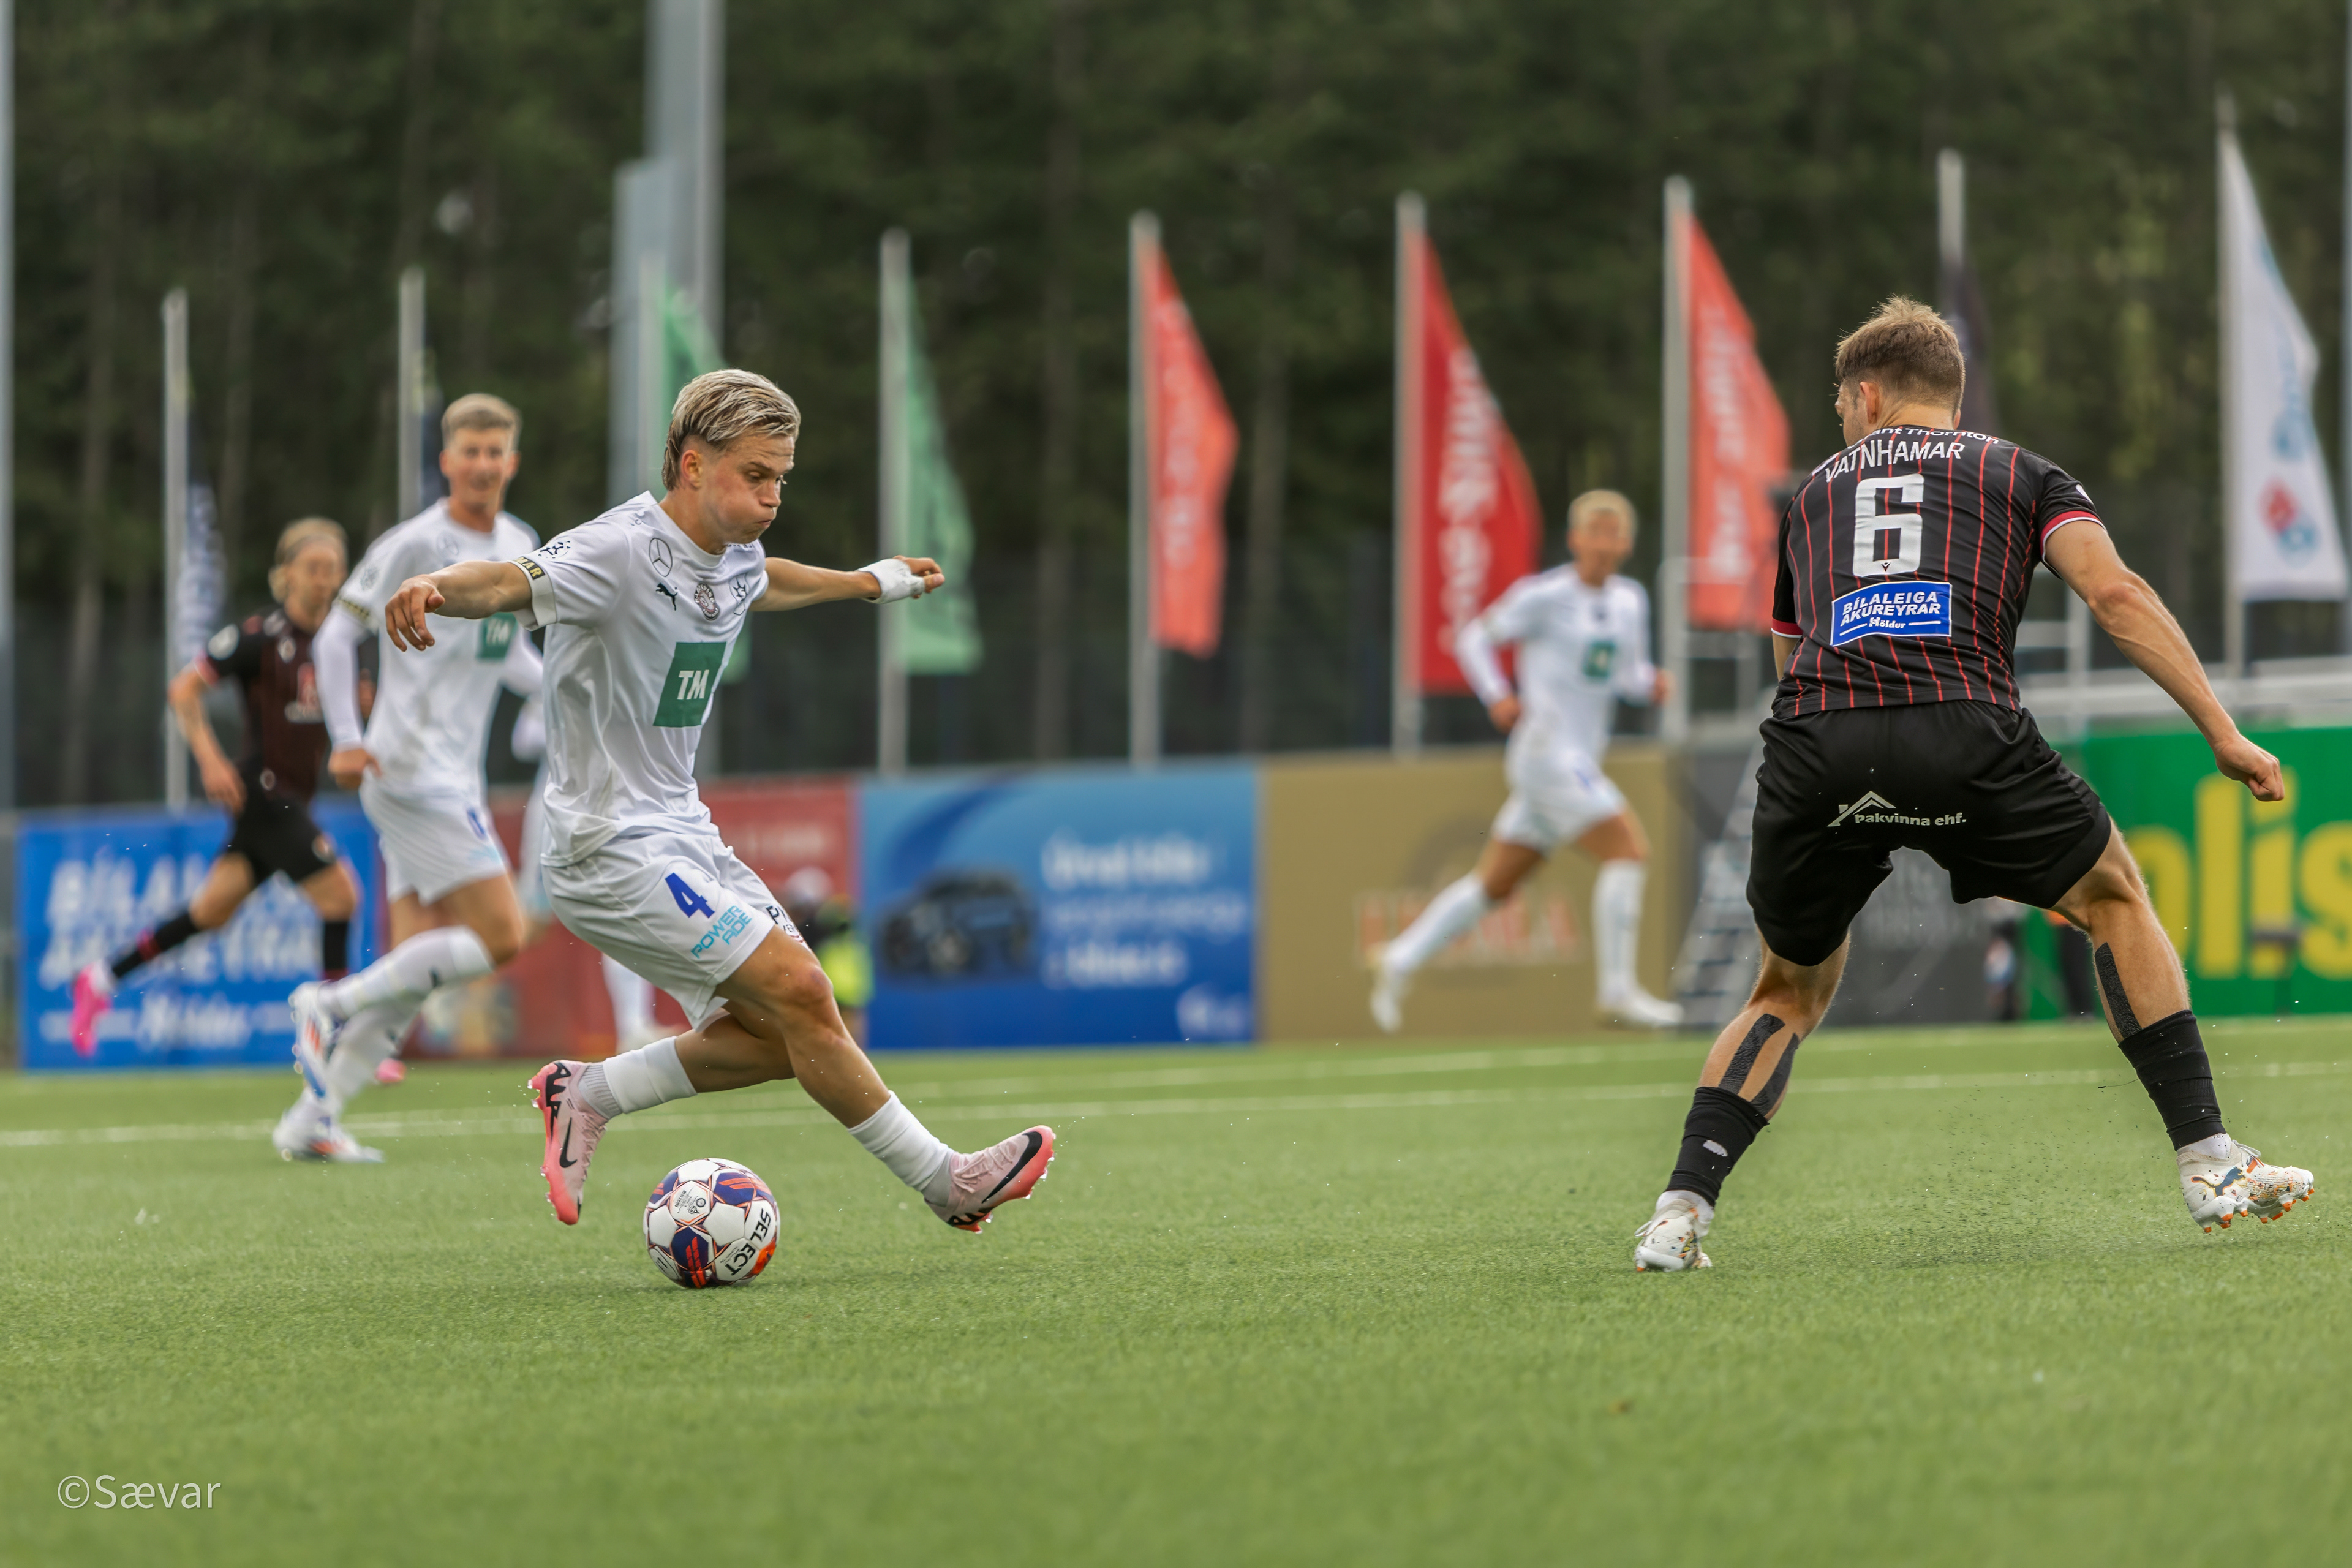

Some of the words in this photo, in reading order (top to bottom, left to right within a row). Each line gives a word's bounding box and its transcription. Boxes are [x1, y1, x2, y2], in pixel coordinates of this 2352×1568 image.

[1905, 428, 1999, 444] Thornton
[1825, 439, 1965, 483] VATNHAMAR
[1853, 473, 1924, 577] 6
[1840, 603, 1941, 627] AKUREYRAR
[1842, 591, 1938, 616] BÍLALEIGA
[677, 669, 709, 701] TM
[1934, 812, 1967, 826] ehf.
[665, 872, 715, 919] 4
[690, 905, 743, 959] POWER
[725, 1208, 772, 1276] SELECT
